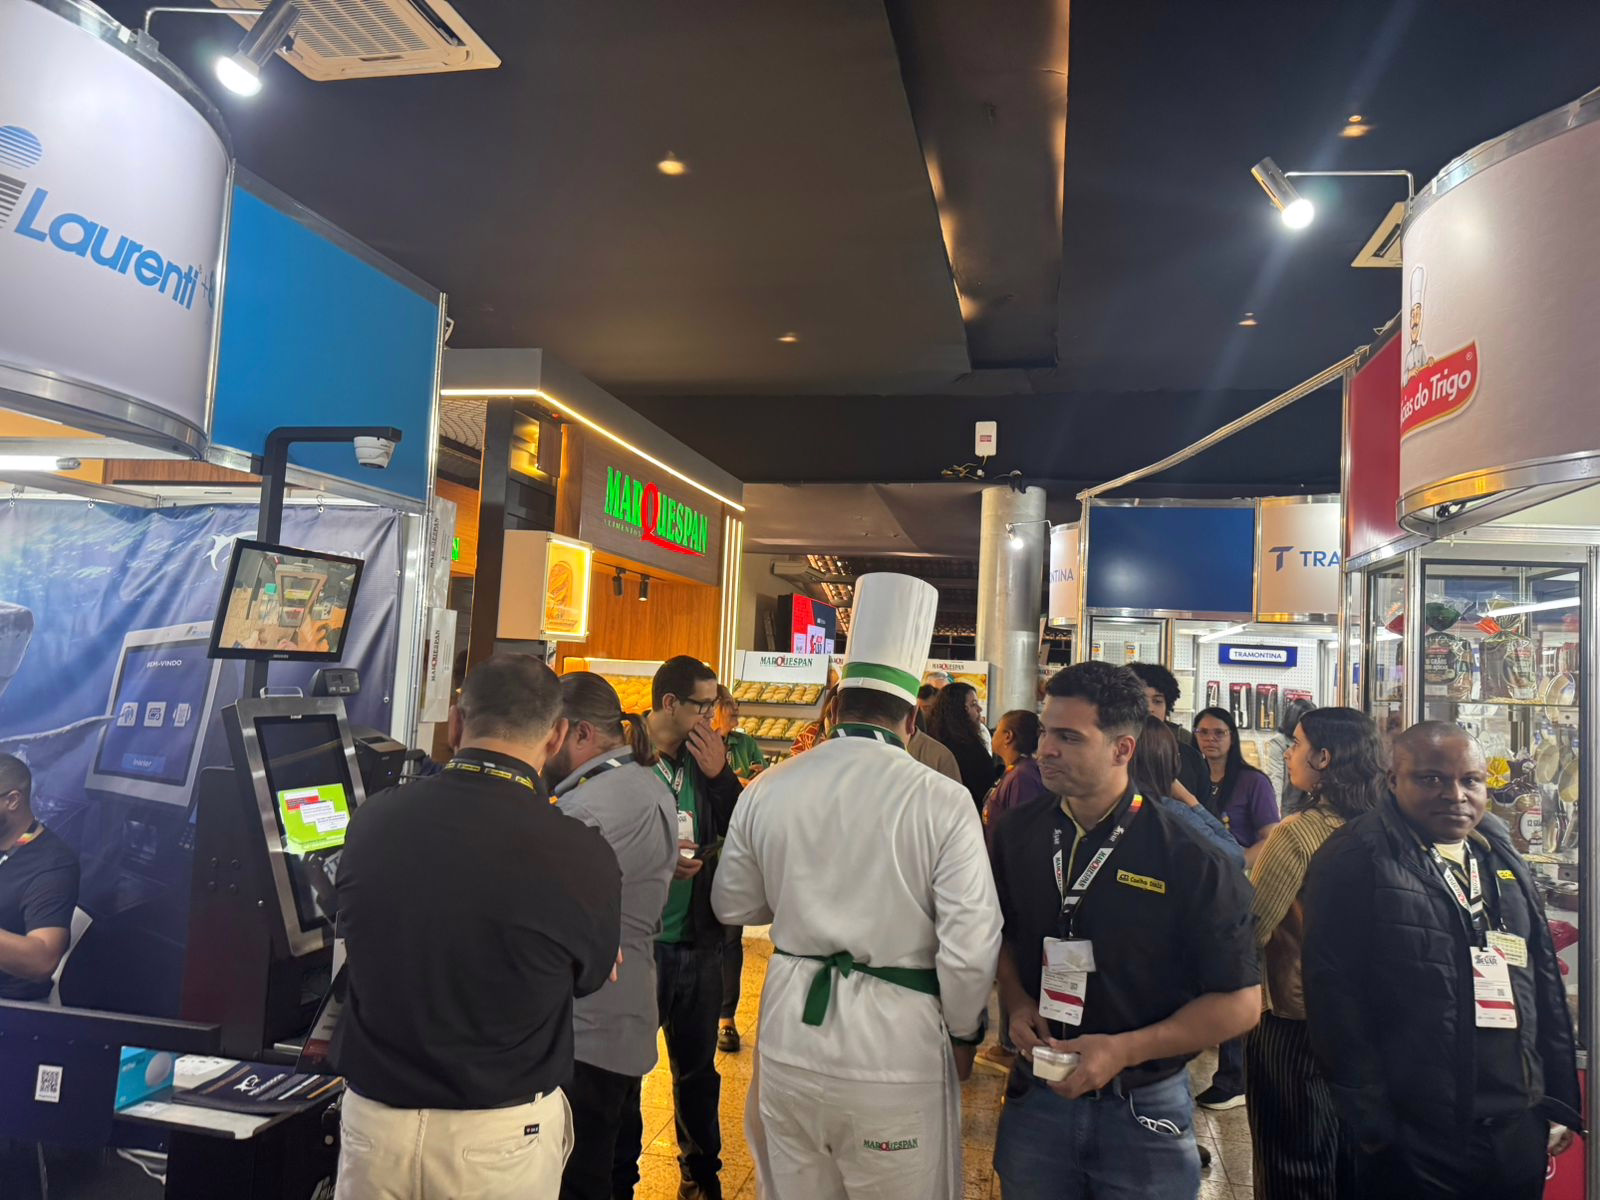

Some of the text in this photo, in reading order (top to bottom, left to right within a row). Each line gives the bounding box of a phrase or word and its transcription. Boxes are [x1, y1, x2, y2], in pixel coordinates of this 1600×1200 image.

[14, 187, 199, 310] Laurenti
[1414, 382, 1429, 412] do
[1430, 368, 1471, 402] Trigo
[604, 466, 708, 556] MARQUESPAN
[1299, 551, 1340, 567] TRA
[760, 655, 813, 668] MARQUESPAN
[1234, 651, 1282, 659] TRAMONTINA
[863, 1138, 918, 1152] MARQUESPAN
